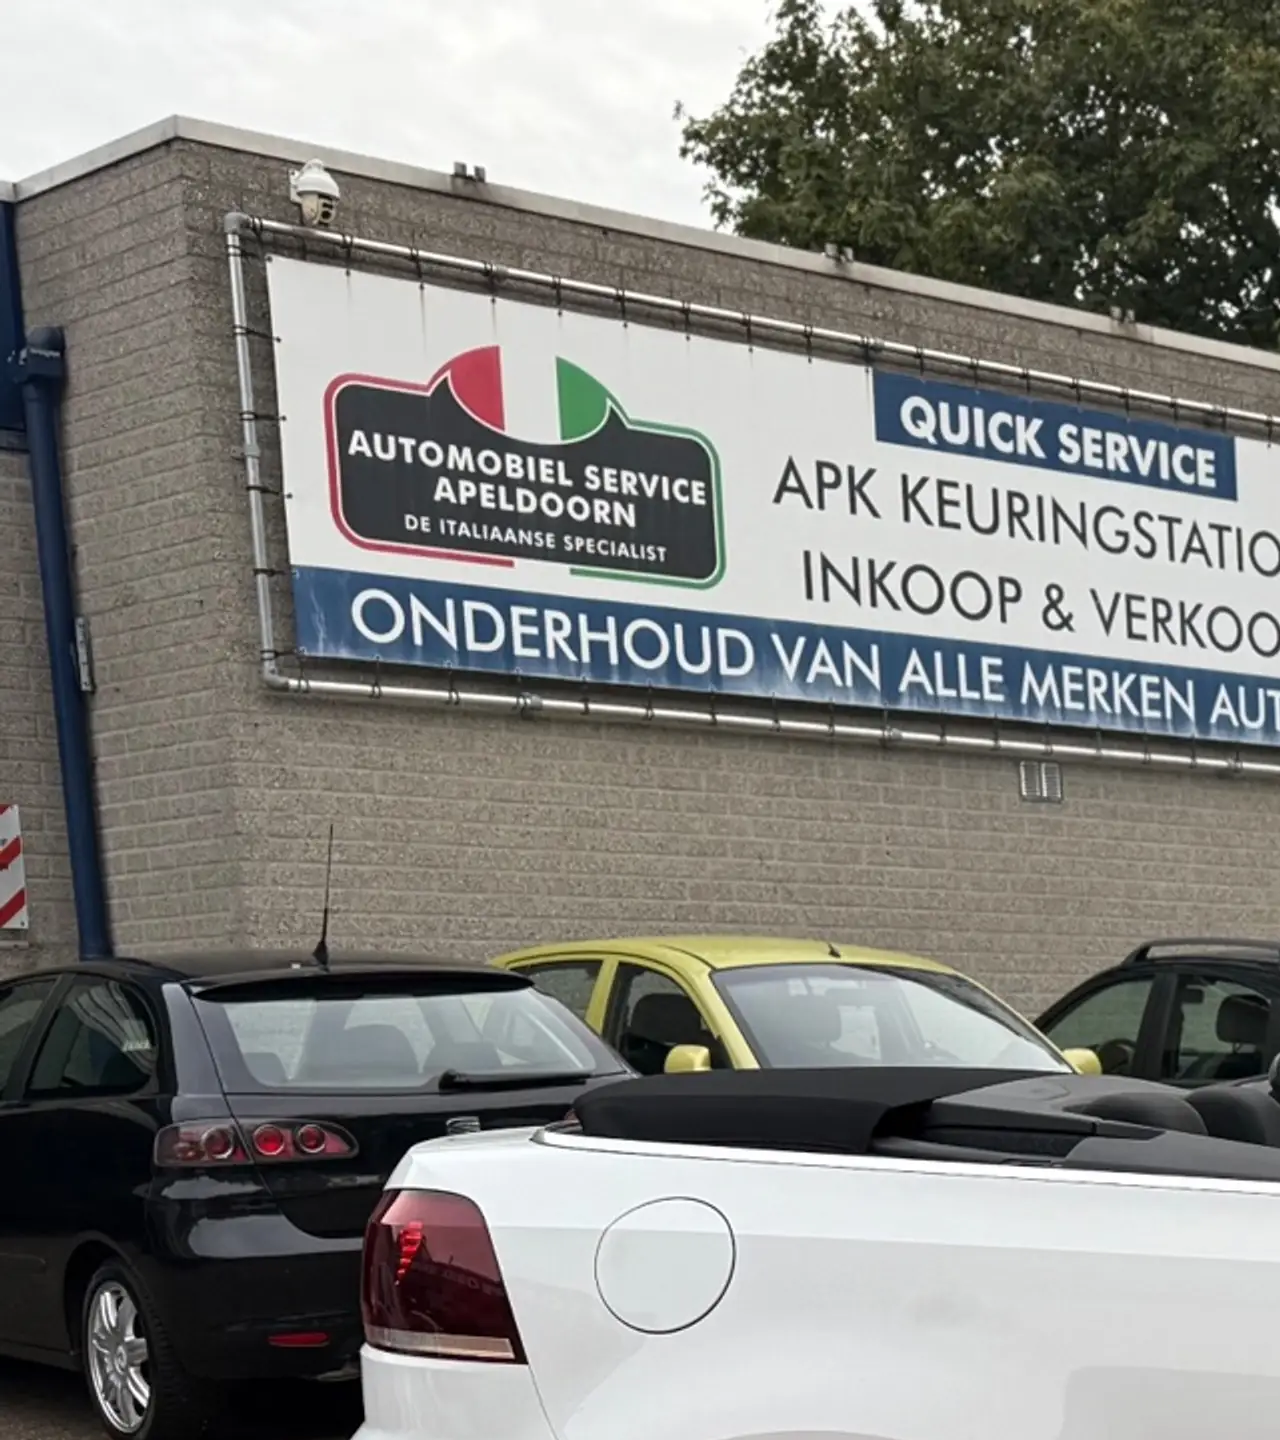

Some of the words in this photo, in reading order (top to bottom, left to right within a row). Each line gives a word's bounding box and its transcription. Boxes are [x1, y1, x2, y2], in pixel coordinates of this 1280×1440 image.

[348, 429, 573, 487] AUTOMOBIEL
[584, 464, 707, 506] SERVICE
[900, 395, 1048, 460] QUICK
[1058, 422, 1218, 489] SERVICE
[433, 476, 637, 529] APELDOORN
[772, 455, 882, 519] APK
[404, 513, 432, 534] DE
[439, 518, 556, 550] ITALIAANSE
[563, 534, 667, 564] SPECIALIST
[803, 549, 1023, 624] INKOOP
[1042, 582, 1076, 633] &
[350, 588, 756, 677] ONDERHOUD
[771, 633, 882, 692] VAN
[898, 647, 1005, 703] ALLE
[1020, 660, 1195, 725] MERKEN
